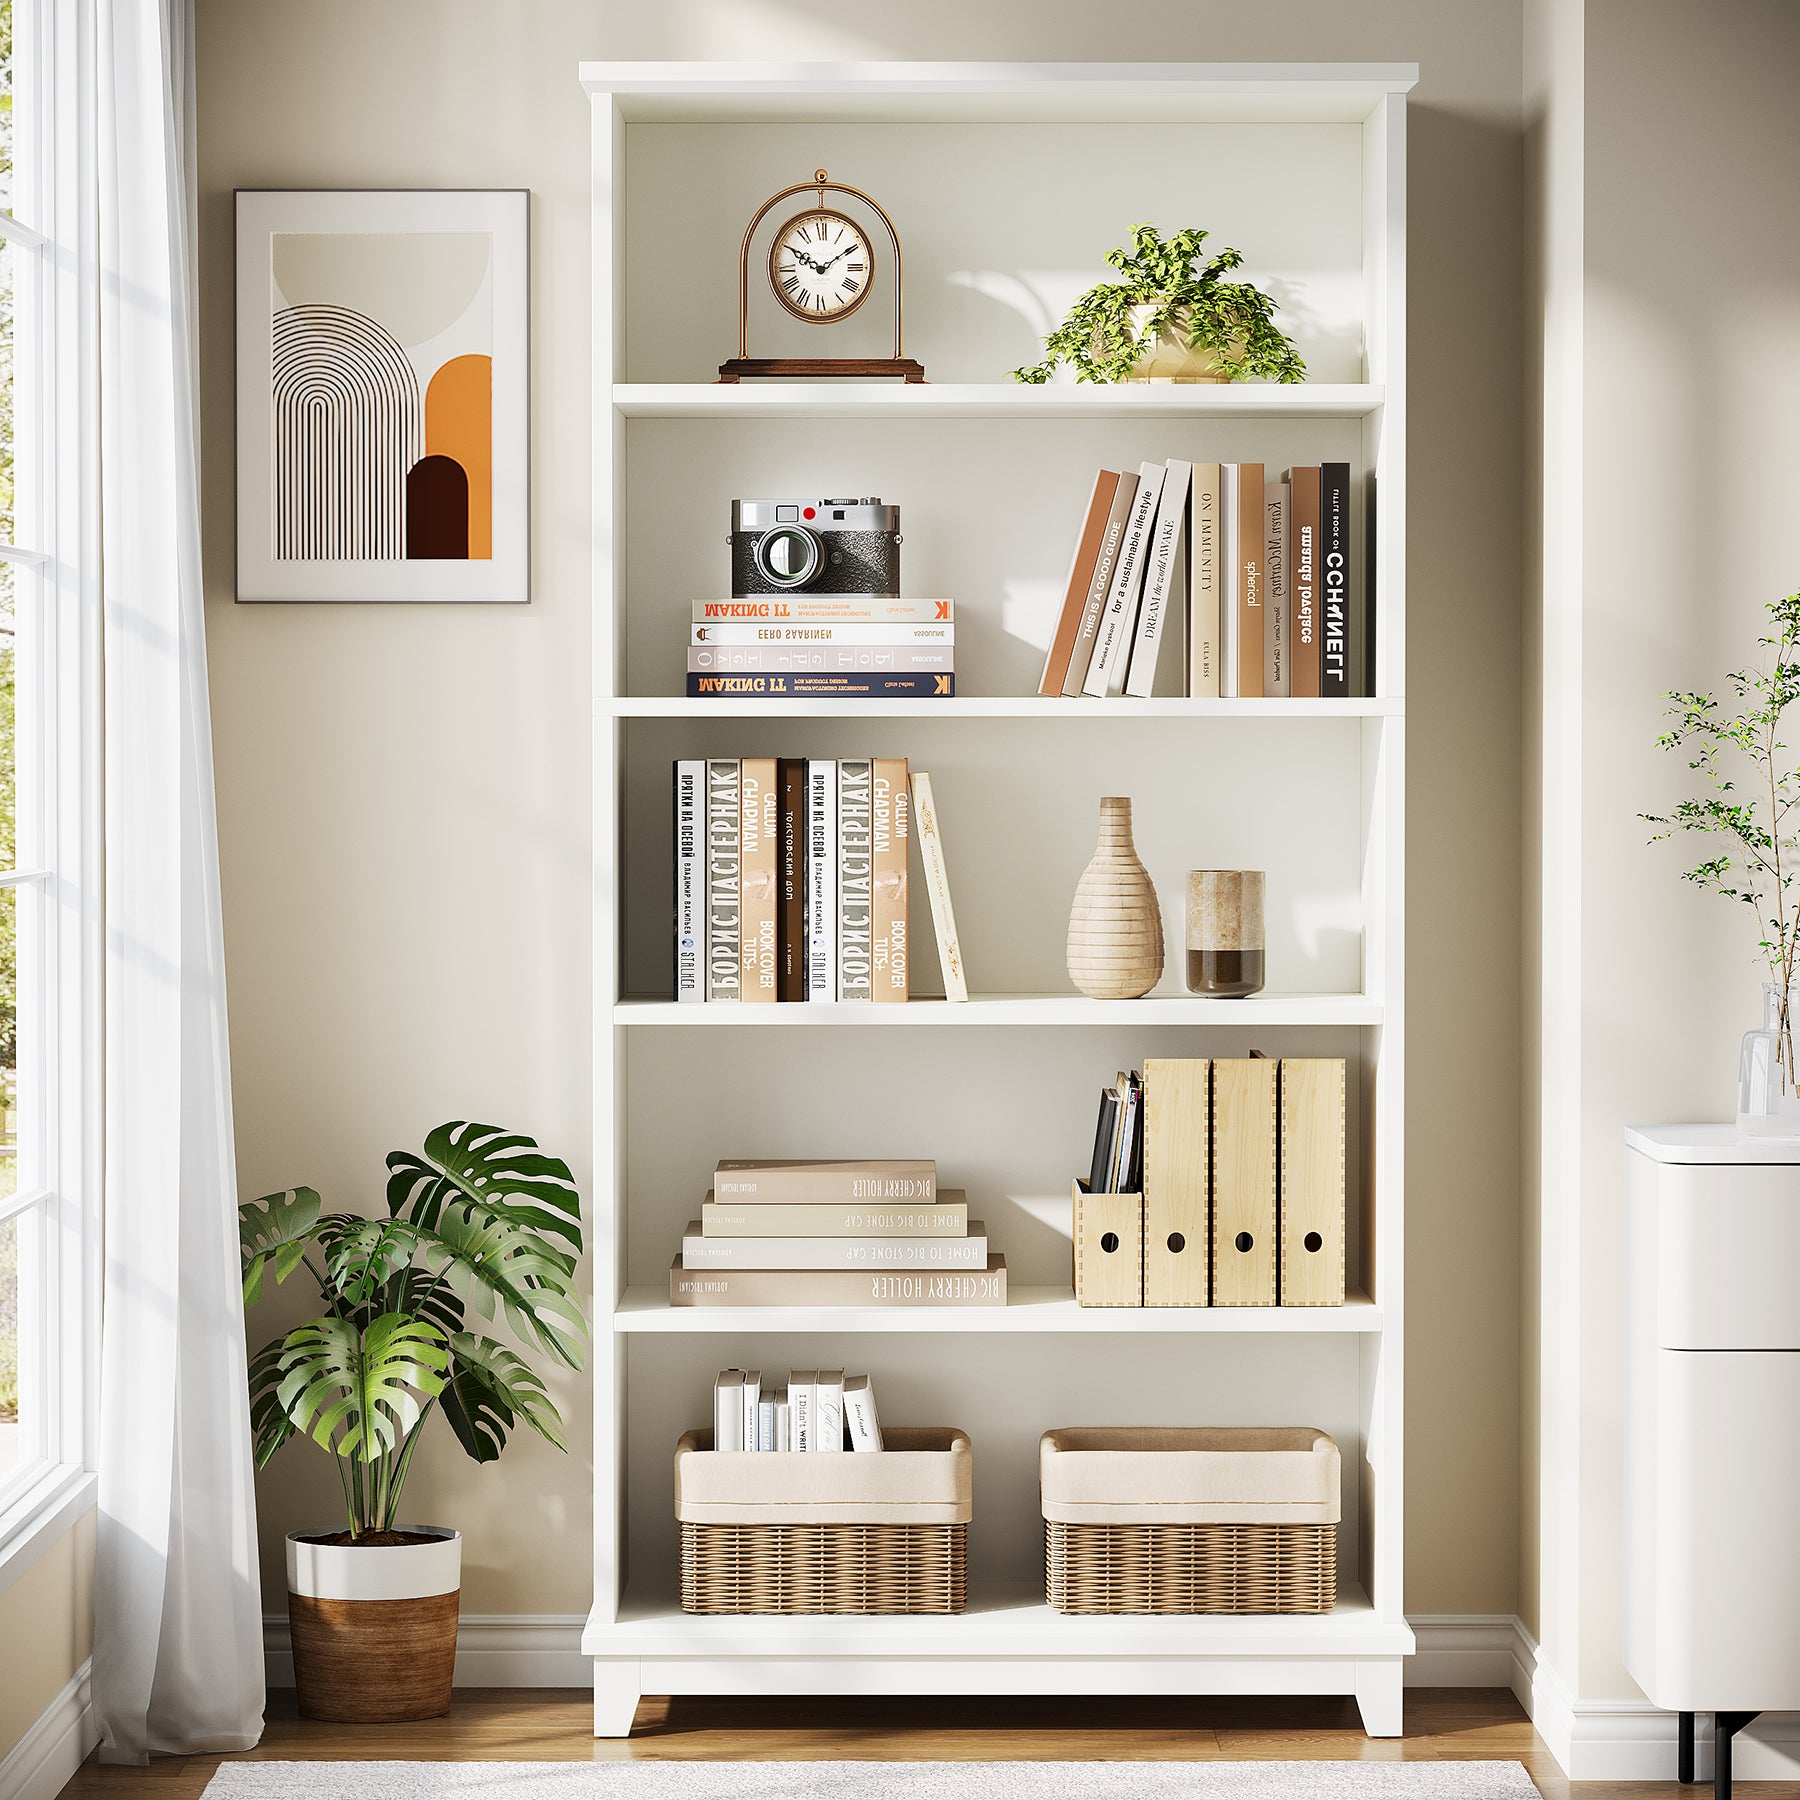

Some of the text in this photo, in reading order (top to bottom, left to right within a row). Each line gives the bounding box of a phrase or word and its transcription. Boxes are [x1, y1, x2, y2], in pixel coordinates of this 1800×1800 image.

[847, 264, 863, 272] III
[1111, 599, 1122, 614] for
[1120, 531, 1141, 588] sustainable
[1134, 490, 1152, 529] lifestyle
[1201, 493, 1212, 593] ON IMMUNITY
[1083, 521, 1121, 639] THIS IS A GOOD GUIDE
[1145, 520, 1175, 639] DREAM the world AWAKE
[1244, 561, 1261, 607] spherical
[1099, 646, 1108, 669] Marieke
[681, 774, 696, 858] ПРЯТКИ НА ОСЕВОЙ
[742, 778, 776, 852] CALLUM CHAPMAN
[813, 774, 827, 858] ПРЯТКИ НА ОСЕВОЙ
[873, 778, 907, 852] CALLUM CHAPMAN
[682, 862, 693, 935] ВЛАДИМИР ВАСИЛЬЕВ
[711, 770, 739, 989] БОРИС ПАСТЕРНАК
[785, 880, 794, 900] ДОМ
[814, 862, 823, 935] ВЛАДИМИР ВАСИЛЬЕВ
[842, 770, 870, 989] БОРИС ПАСТЕРНАК
[743, 920, 774, 988] BOOK COVER TUTS+
[874, 920, 905, 988] BOOK COVER TUTS+
[844, 1214, 960, 1227] HOME TO BIG STONE GAP
[852, 1179, 931, 1197] BIG CHERRY HOLLER
[679, 1281, 728, 1292] ADRIANA TRIGIANI
[846, 1246, 978, 1260] HOME TO BIG STONE GAP
[871, 1277, 999, 1298] BIG CHERRY HOLLER
[799, 1401, 807, 1428] Didn't
